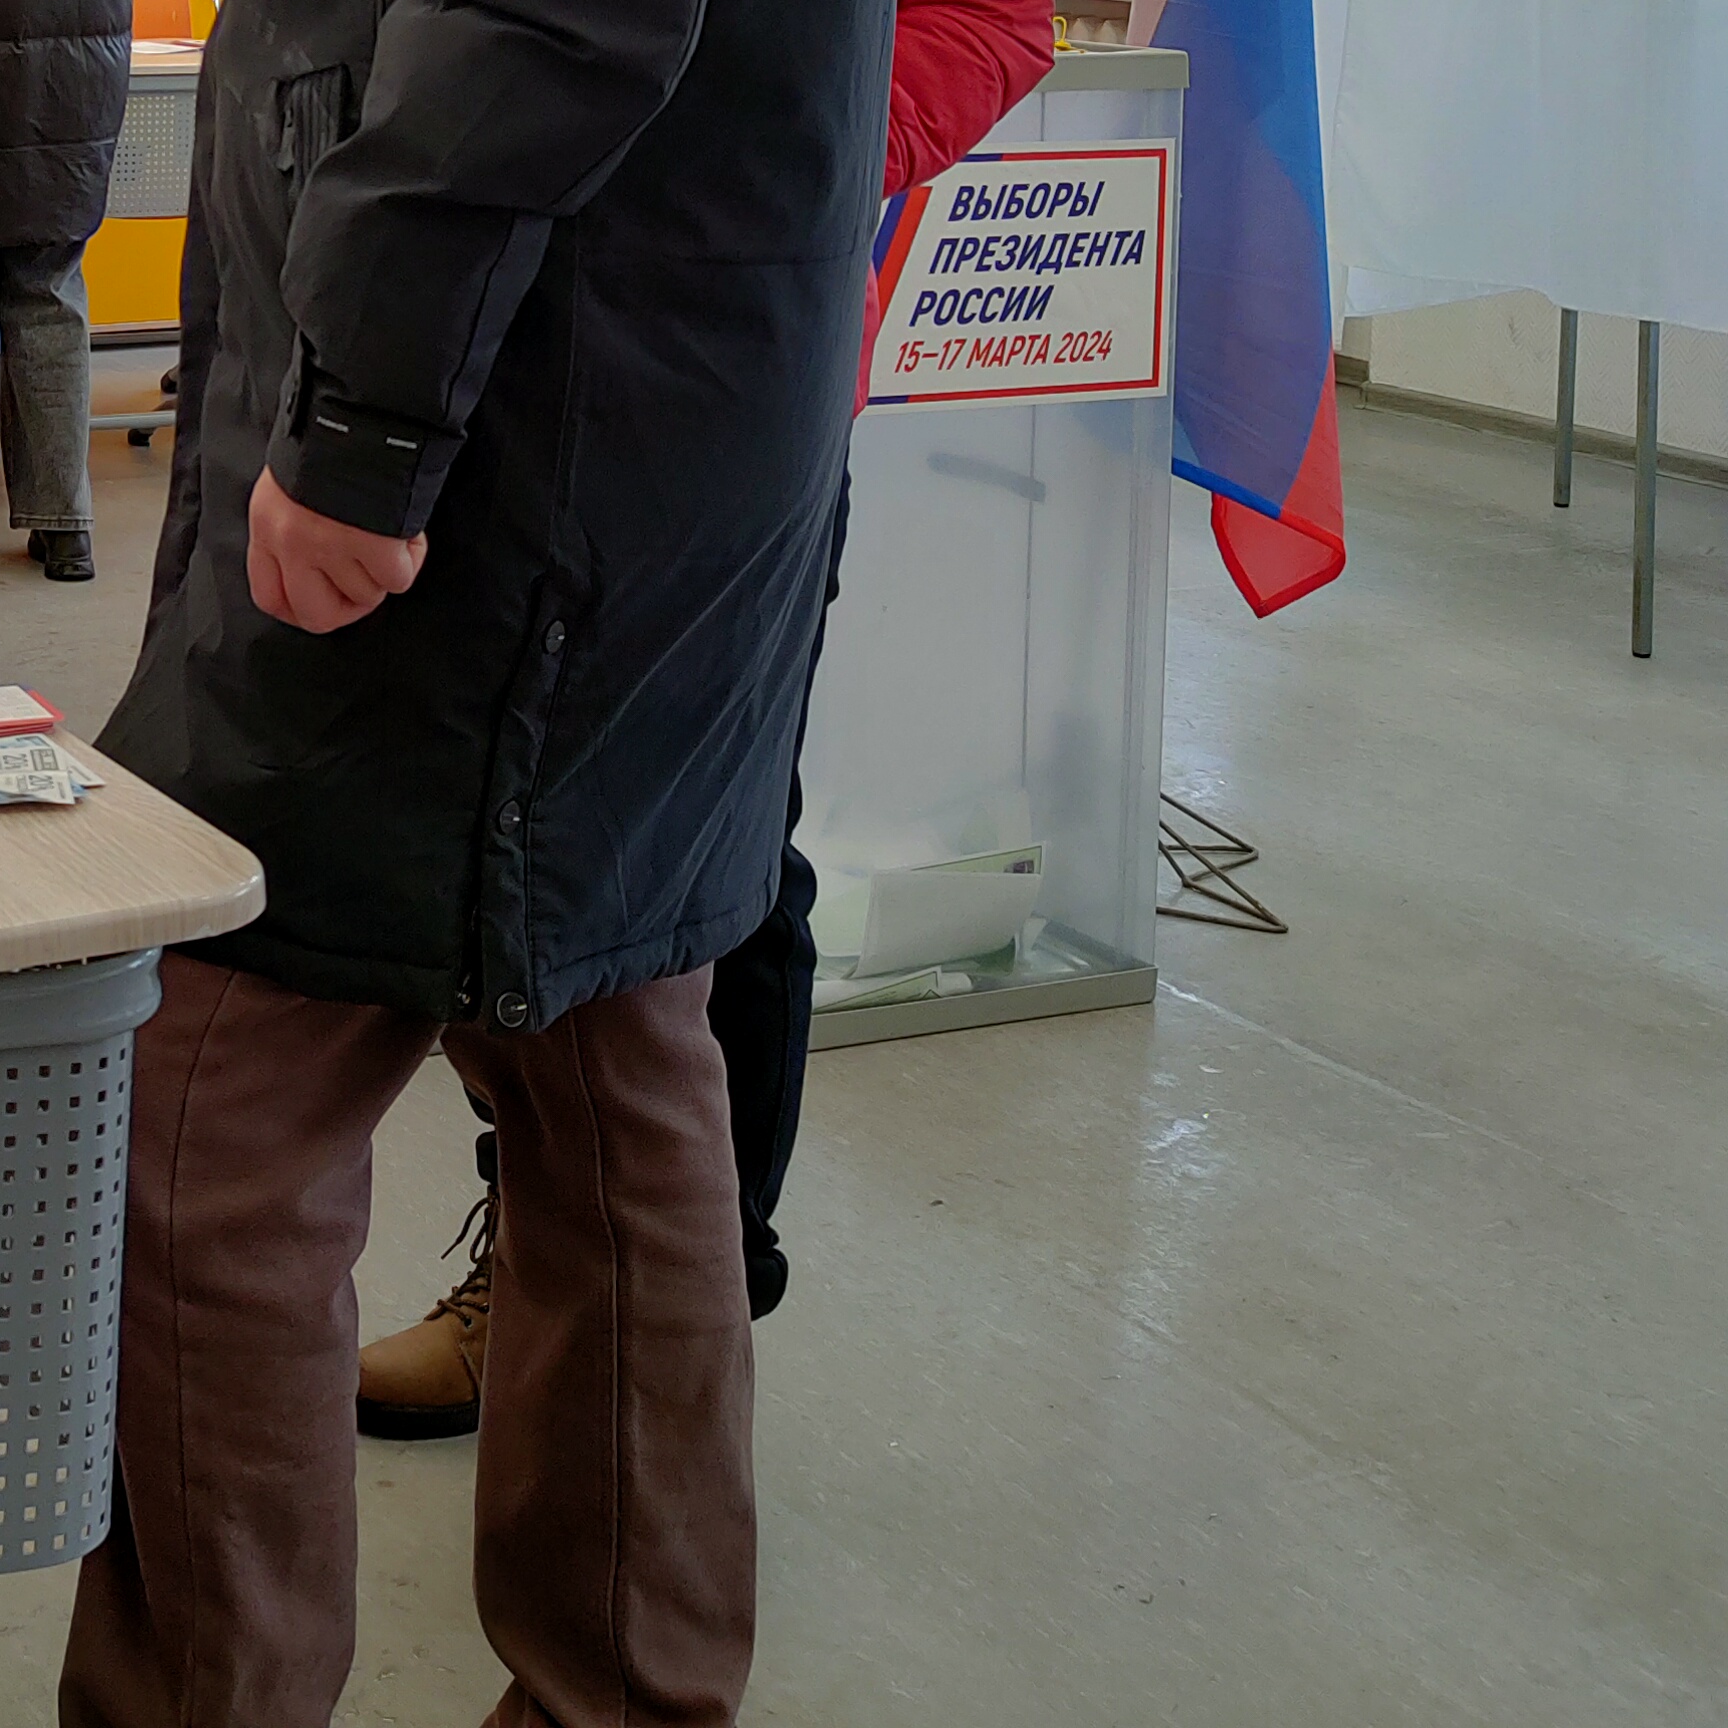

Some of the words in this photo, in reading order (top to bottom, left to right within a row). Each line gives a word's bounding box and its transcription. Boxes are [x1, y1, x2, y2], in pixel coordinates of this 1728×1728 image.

[947, 181, 1105, 223] ВЫБОРЫ
[927, 230, 1145, 276] ПРЕЗИДЕНТА
[909, 284, 1054, 328] РОССИИ
[966, 334, 1051, 370] МАРТА
[1053, 330, 1113, 364] 2024
